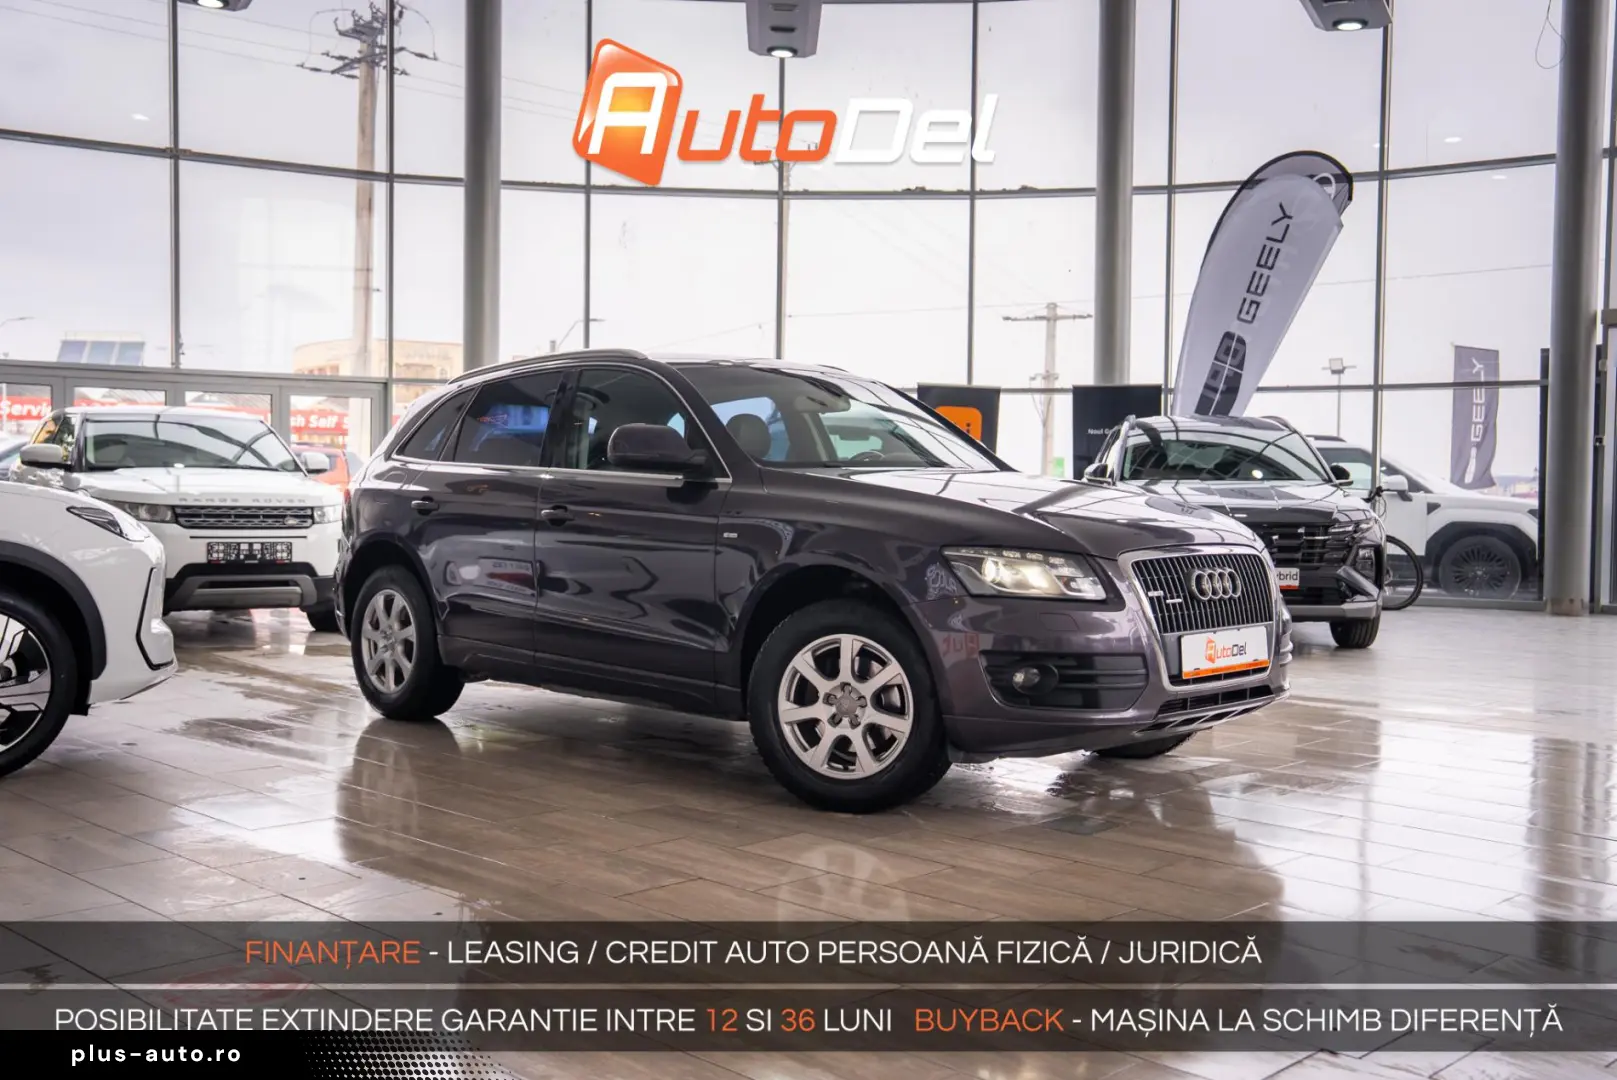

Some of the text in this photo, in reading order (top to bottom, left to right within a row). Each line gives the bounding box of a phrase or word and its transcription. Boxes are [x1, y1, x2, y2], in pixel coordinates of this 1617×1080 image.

[1237, 202, 1294, 324] GEELY
[310, 415, 337, 428] Self
[1276, 571, 1298, 581] brid
[1205, 639, 1247, 663] AutoDel
